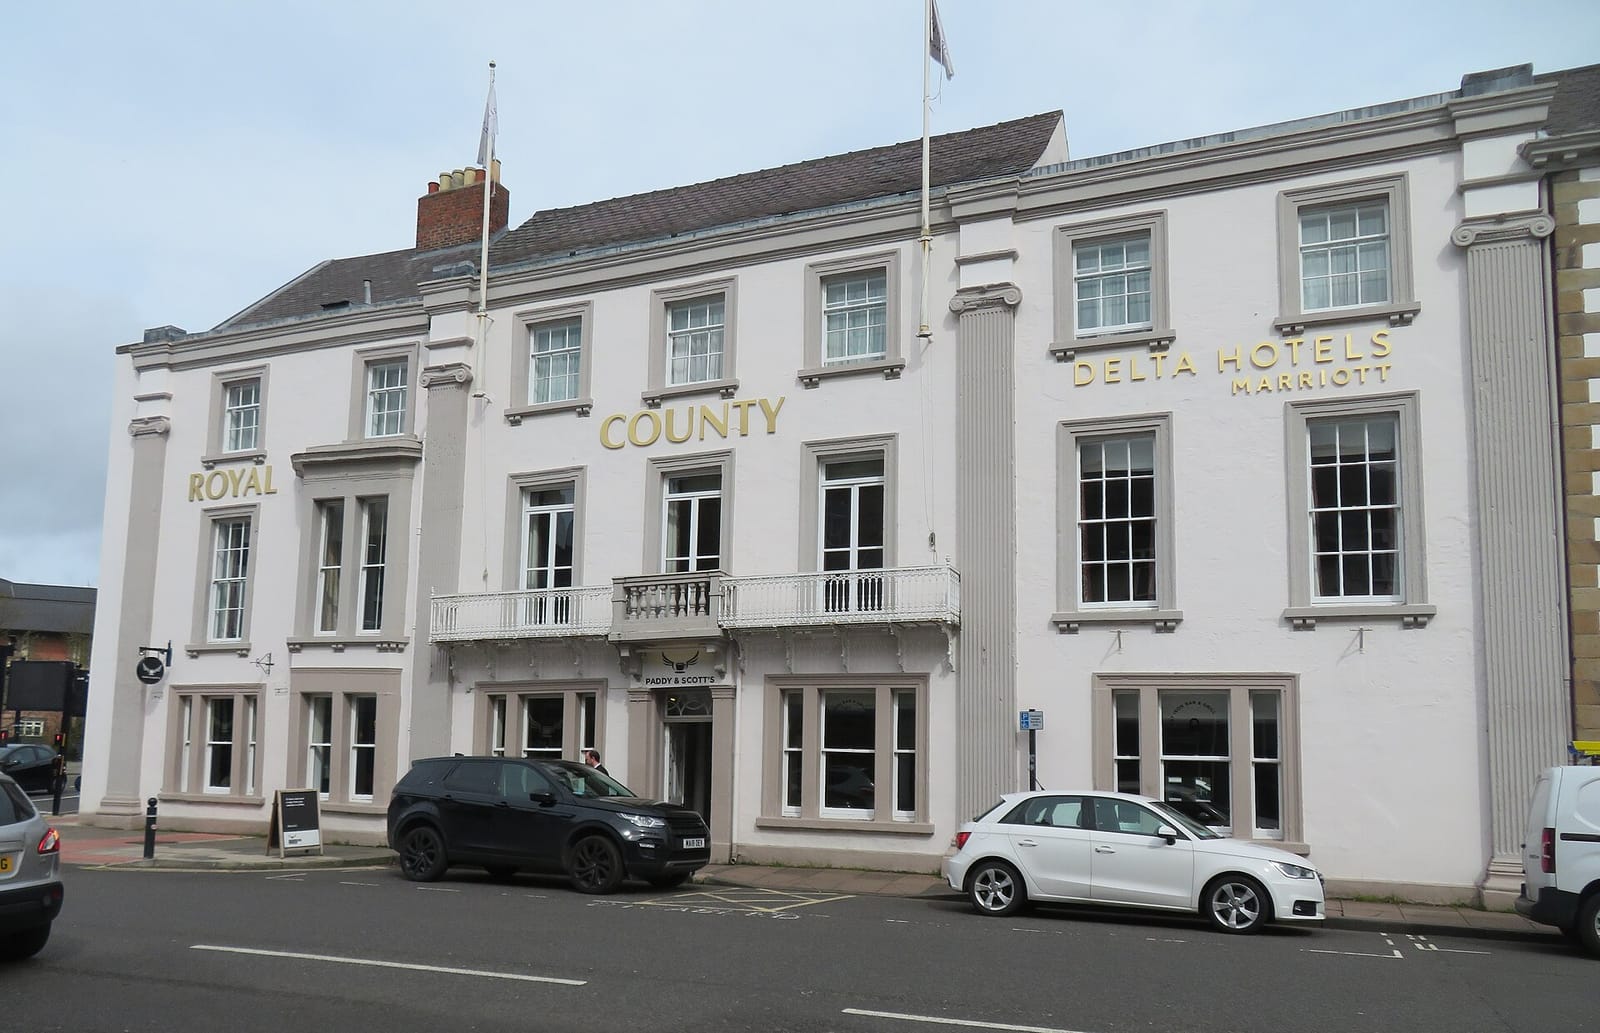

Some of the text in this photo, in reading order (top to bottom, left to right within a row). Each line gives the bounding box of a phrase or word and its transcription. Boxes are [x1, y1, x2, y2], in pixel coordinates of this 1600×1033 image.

[1074, 329, 1393, 386] DELTA HOTELS
[1231, 364, 1392, 395] MARRIOTT
[600, 396, 785, 449] COUNTY
[189, 465, 277, 502] ROYAL
[645, 677, 672, 685] PADDY
[681, 675, 715, 684] SCOTT'S
